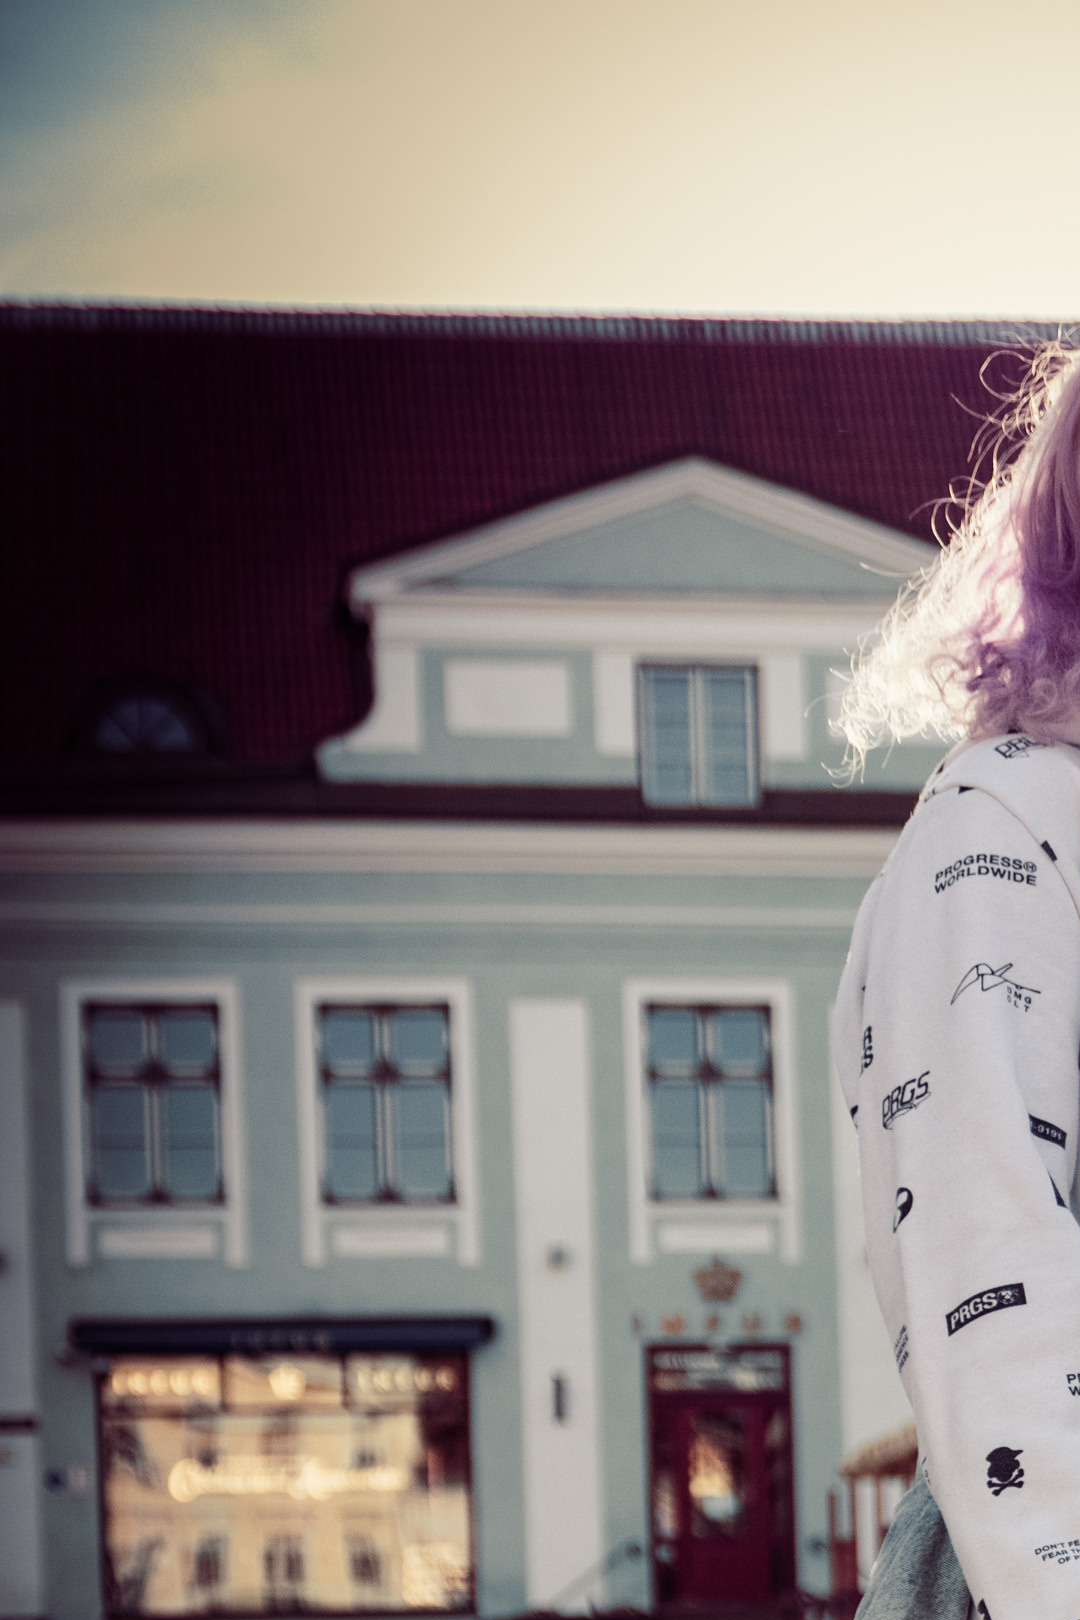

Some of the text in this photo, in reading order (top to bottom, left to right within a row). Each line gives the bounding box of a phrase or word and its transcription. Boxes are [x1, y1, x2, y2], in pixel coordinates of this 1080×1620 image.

[934, 865, 1038, 894] WORLDWIDE
[950, 1293, 998, 1330] PRGS
[1042, 1549, 1069, 1562] FEAR
[1057, 1556, 1071, 1565] OF
